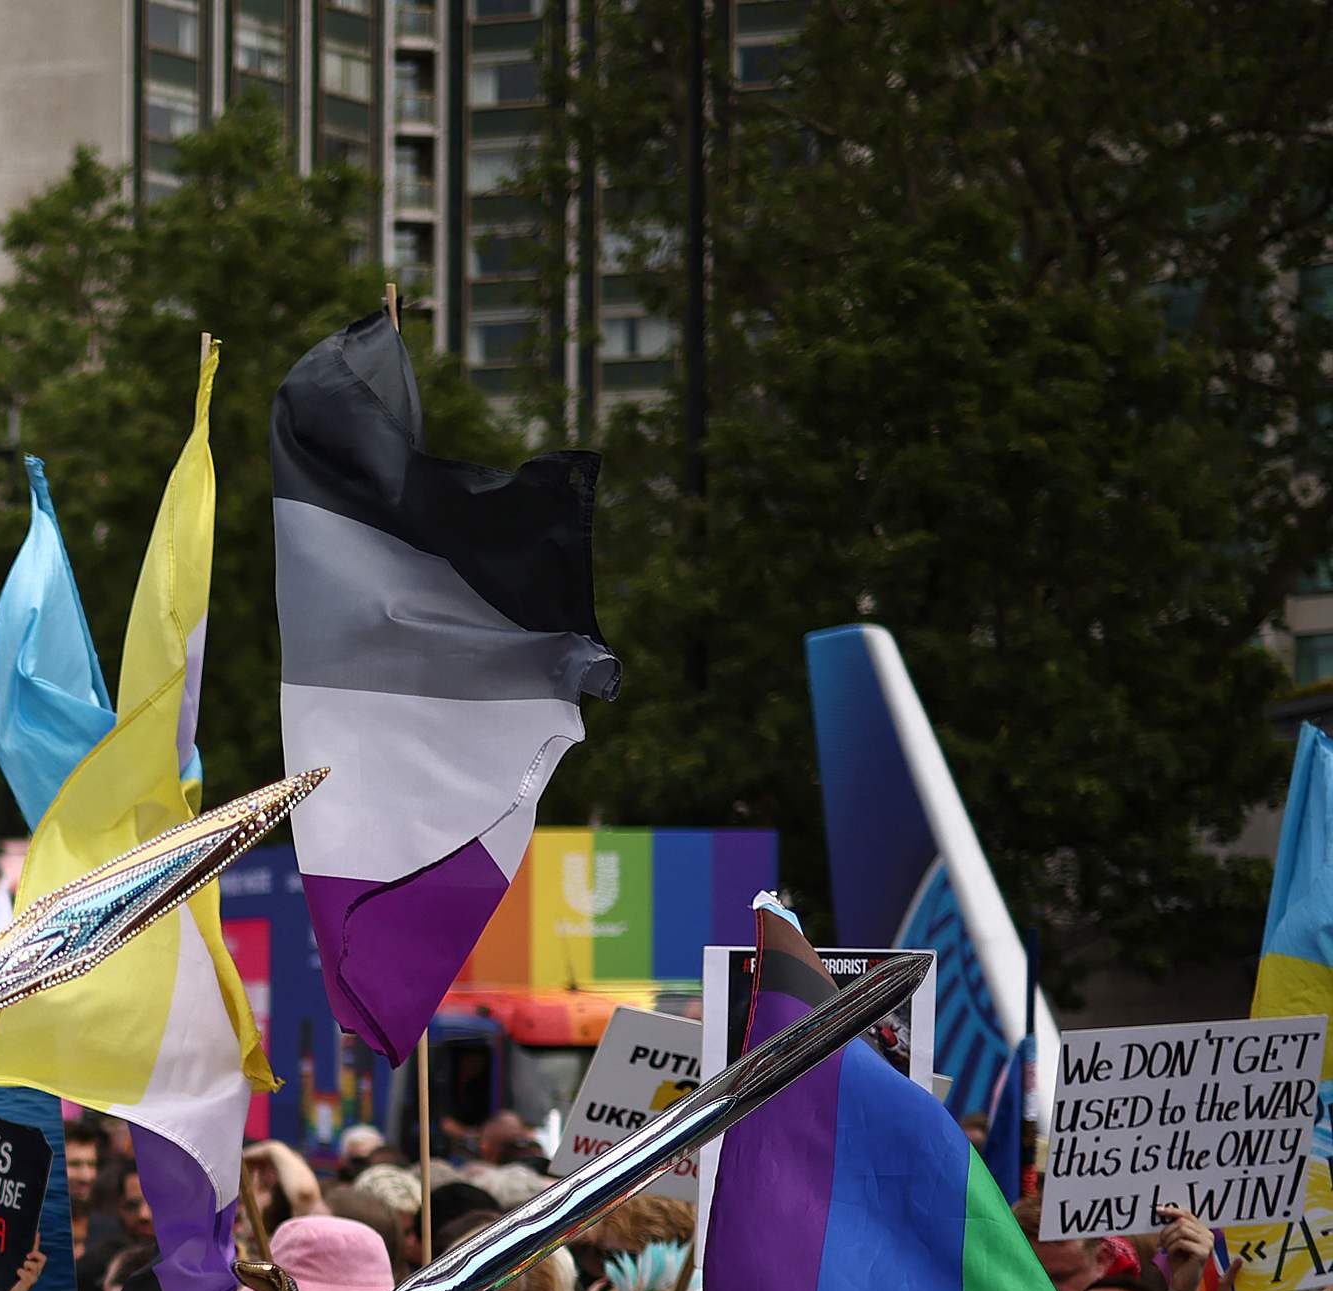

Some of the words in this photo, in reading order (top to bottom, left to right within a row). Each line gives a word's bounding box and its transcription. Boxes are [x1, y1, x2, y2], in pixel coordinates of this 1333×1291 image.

[1063, 1041, 1113, 1086] We
[1119, 1029, 1234, 1081] DON'T
[1233, 1031, 1321, 1075] GET
[586, 1101, 649, 1130] UKR
[1054, 1095, 1153, 1133] USED
[1159, 1088, 1186, 1127] to
[1195, 1082, 1239, 1123] the
[1242, 1079, 1316, 1121] WAR
[1052, 1136, 1122, 1178] this
[1130, 1135, 1161, 1174] is
[1167, 1129, 1210, 1171] the
[1216, 1128, 1303, 1167] ONLY
[1059, 1193, 1141, 1235] WAY
